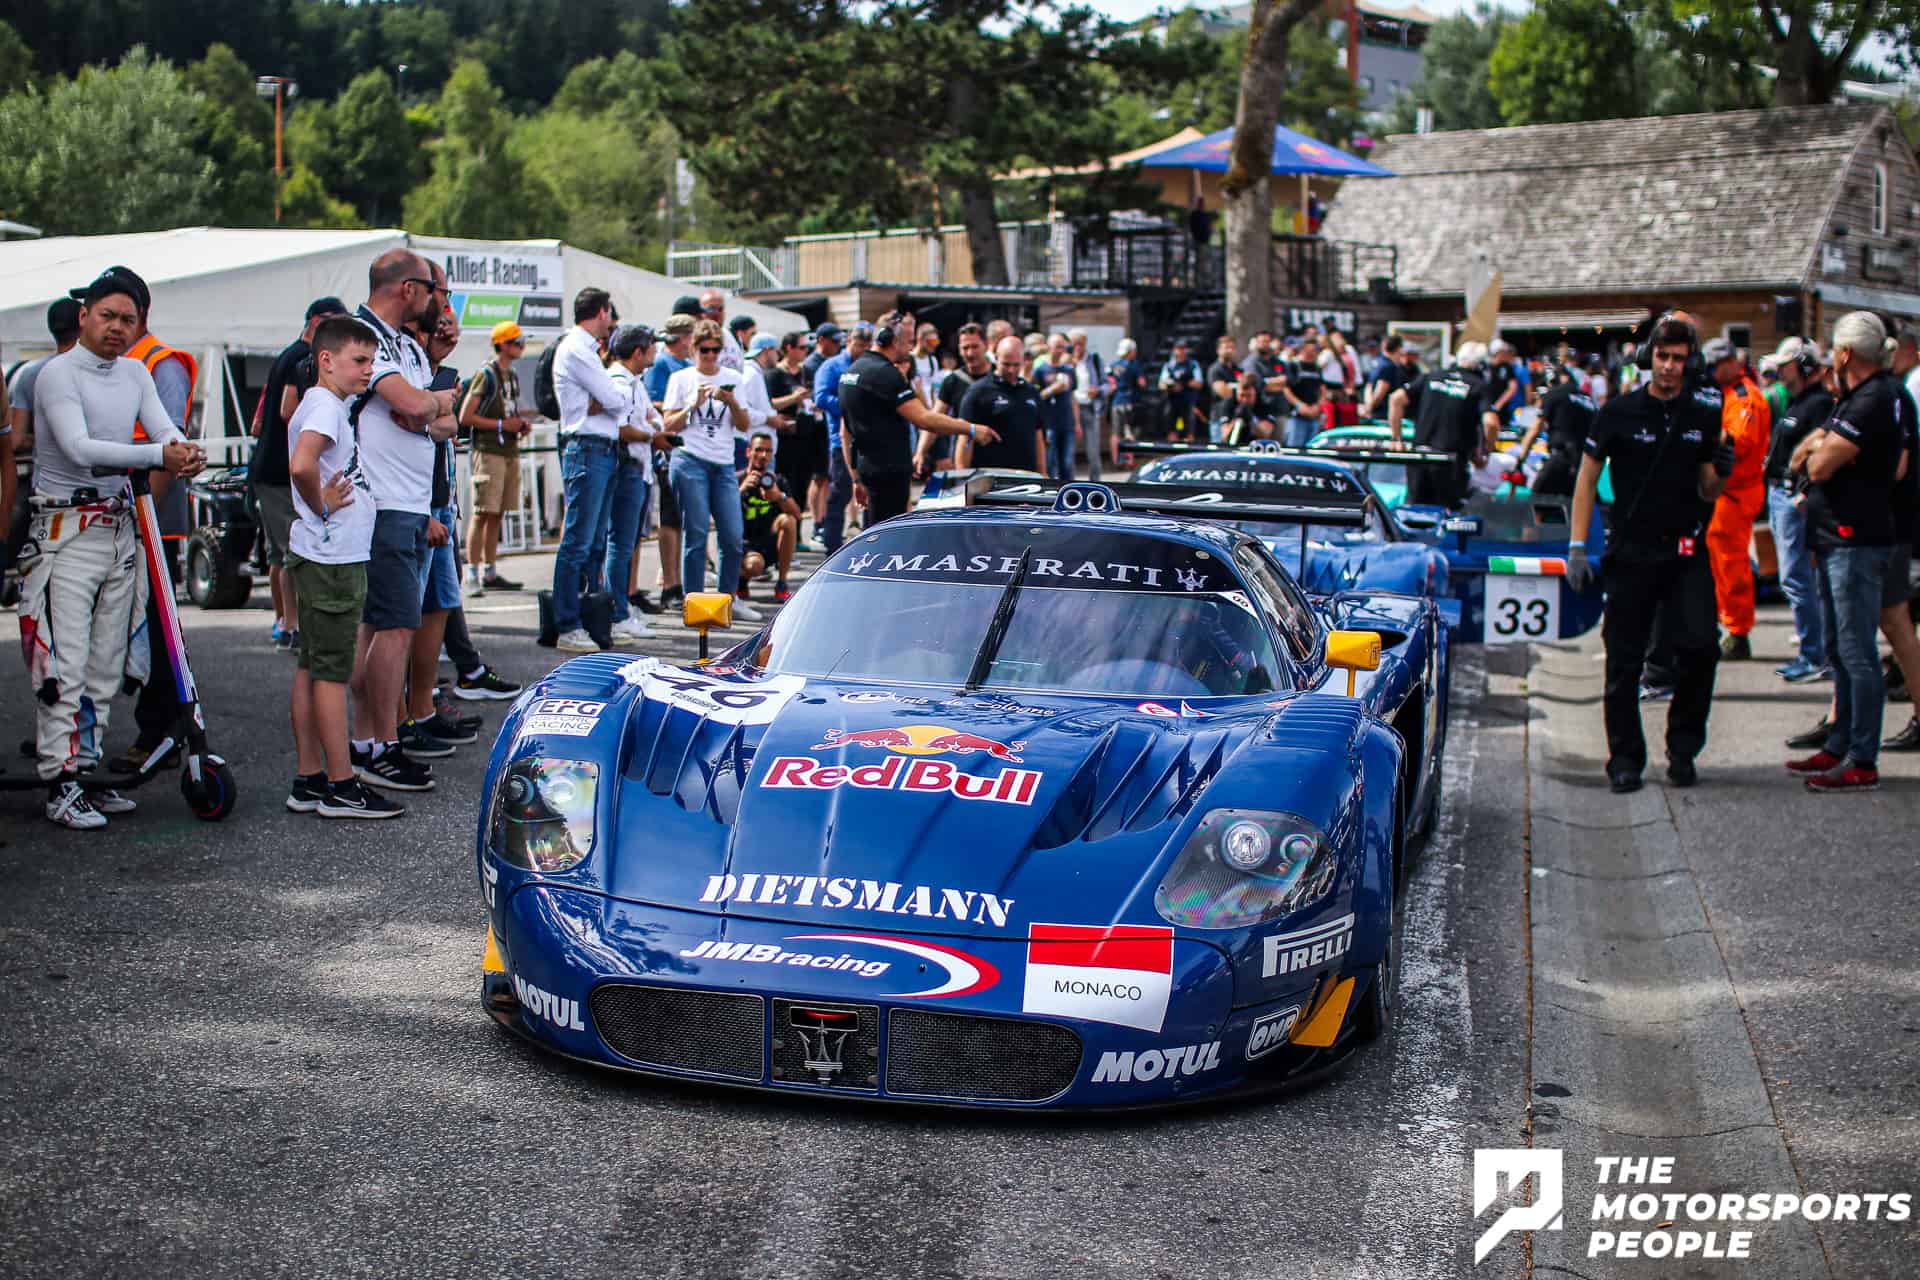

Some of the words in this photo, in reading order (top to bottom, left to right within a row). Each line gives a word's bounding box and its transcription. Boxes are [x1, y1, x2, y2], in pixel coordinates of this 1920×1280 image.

[446, 256, 538, 290] Allied-Racing
[879, 553, 1163, 588] MASERATI
[1493, 598, 1550, 637] 33
[538, 700, 601, 715] EFG
[760, 756, 904, 790] Red
[904, 760, 1044, 806] Bull
[699, 872, 1015, 928] DIETSMANN
[679, 940, 891, 977] JMBracing
[1261, 912, 1355, 978] PIRELLI
[514, 973, 585, 1032] MOTUL
[1054, 979, 1143, 1001] MONACO
[1251, 1009, 1297, 1051] OMP
[1091, 1040, 1222, 1083] MOTUL
